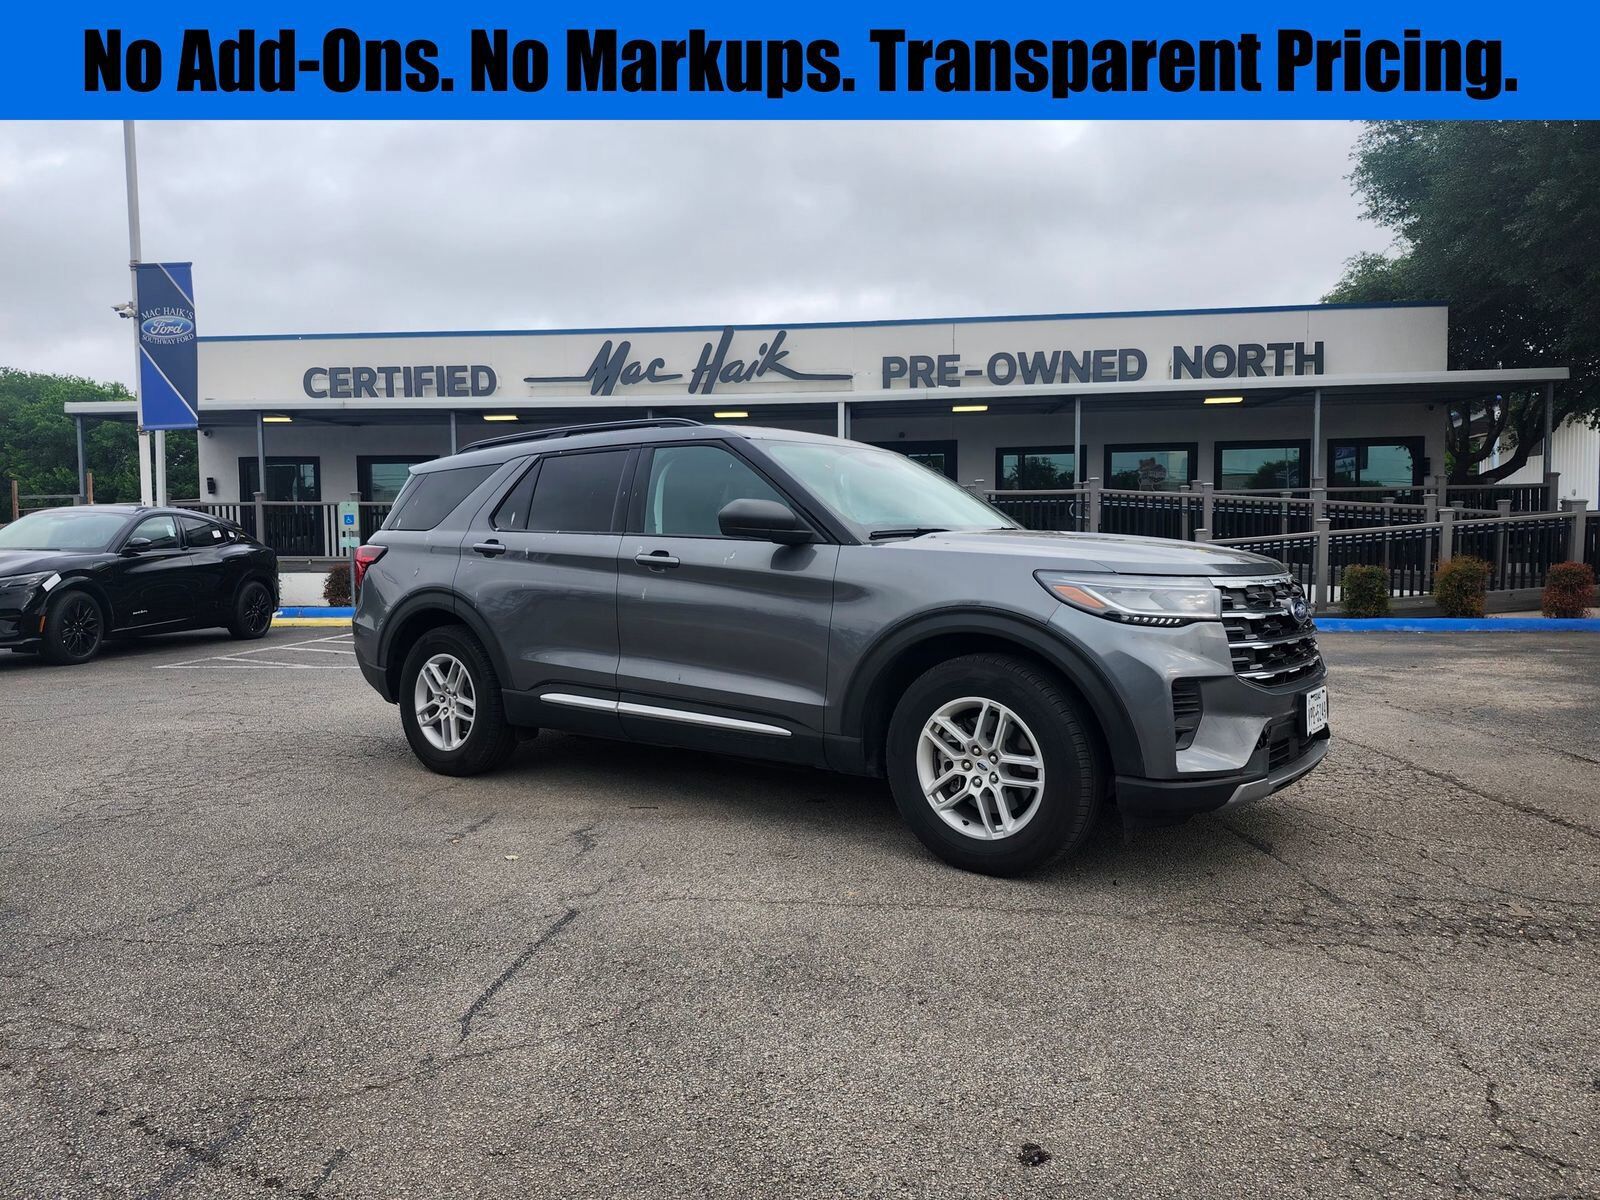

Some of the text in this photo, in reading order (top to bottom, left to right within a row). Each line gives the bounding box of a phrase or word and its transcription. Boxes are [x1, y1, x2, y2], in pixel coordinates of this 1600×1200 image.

[141, 306, 194, 321] MAC HAIK'S
[150, 318, 184, 334] Ford
[142, 333, 194, 345] SOUTHWAY FORD
[302, 325, 1325, 399] CERTIFIED Mac Haik PRE-OWNED NORTH
